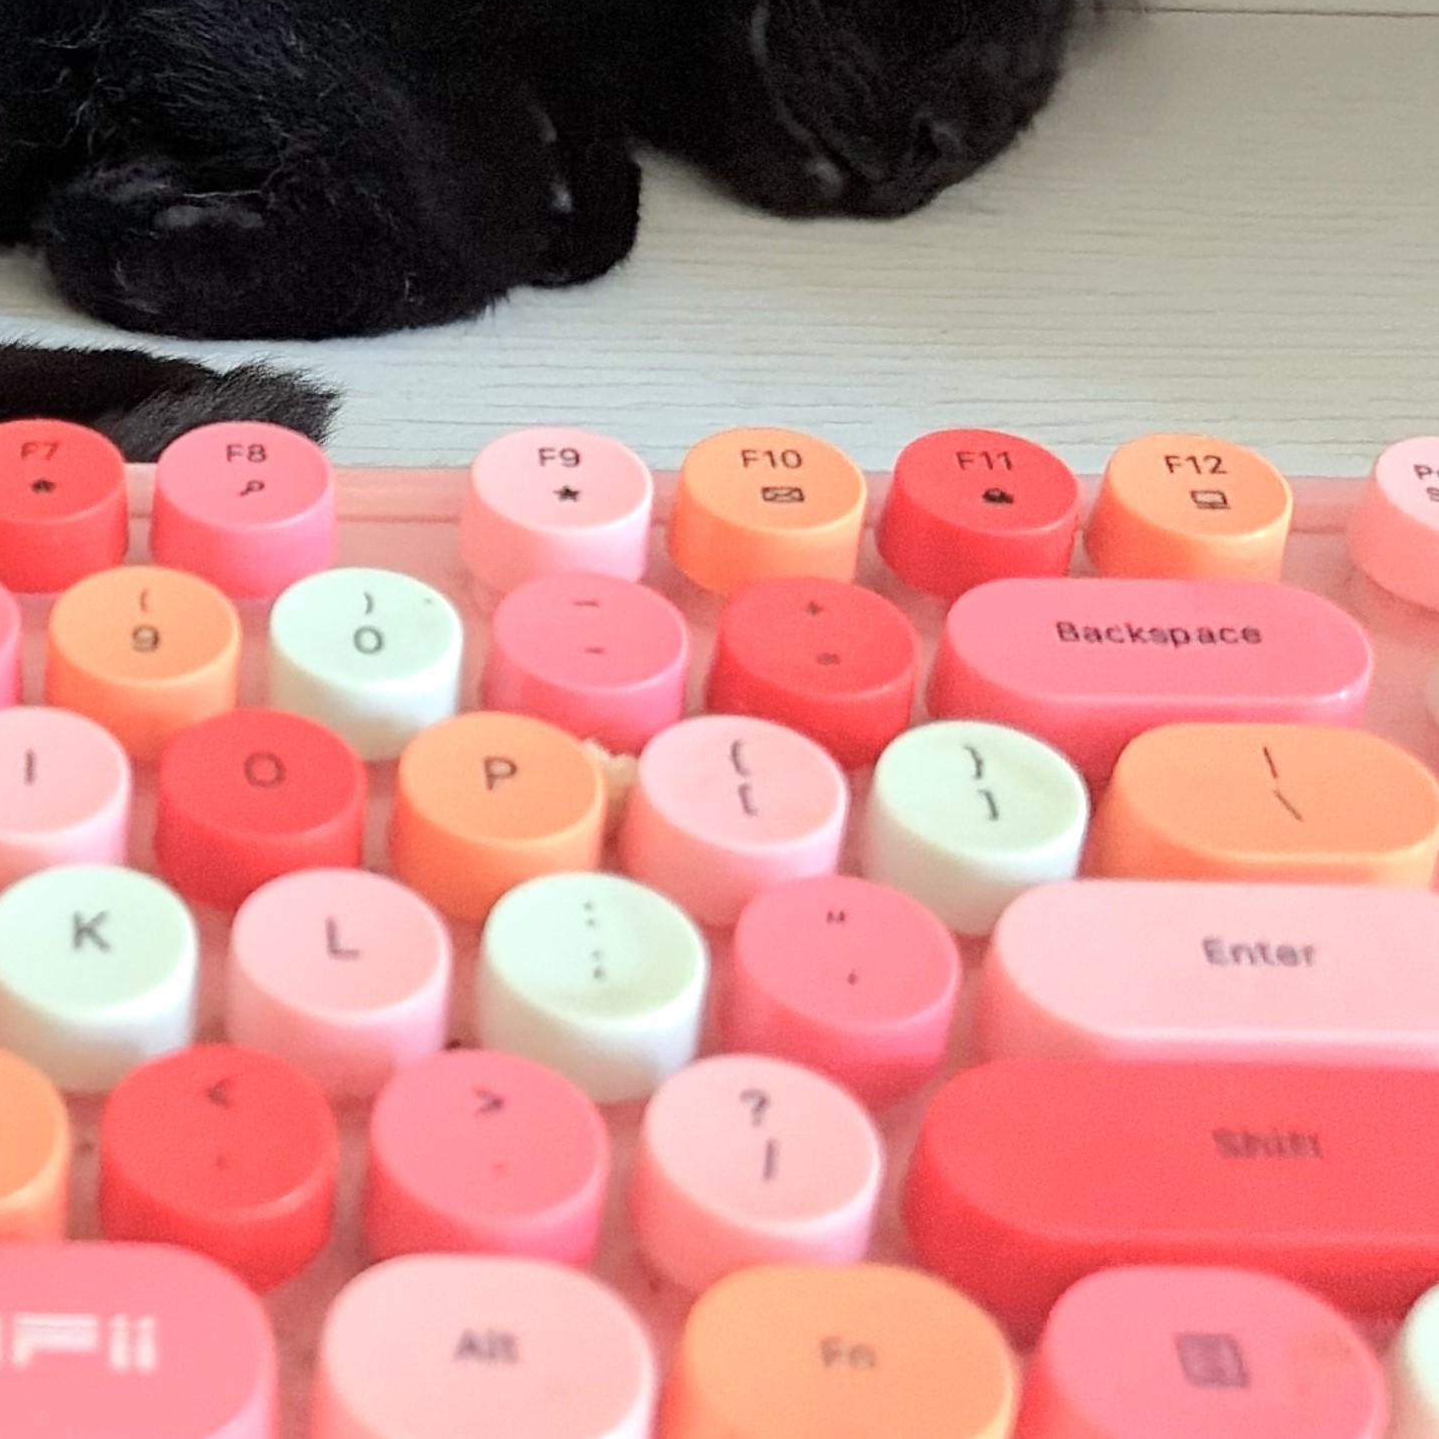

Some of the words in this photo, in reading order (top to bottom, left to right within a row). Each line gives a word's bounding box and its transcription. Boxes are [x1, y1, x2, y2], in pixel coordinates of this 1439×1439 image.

[21, 441, 60, 461] F7
[226, 444, 267, 463] F8
[539, 448, 581, 467] F9
[741, 450, 802, 469] F10
[956, 451, 1012, 470] F11
[1164, 455, 1226, 474] F12
[139, 589, 148, 613] (
[364, 592, 374, 615] )
[132, 625, 161, 652] 9
[1056, 621, 1262, 648] Backspace
[25, 749, 36, 784] I
[484, 757, 519, 791] P
[73, 912, 110, 951] K
[326, 918, 360, 960] L
[1202, 938, 1315, 967] Enter
[476, 1090, 504, 1114] >
[740, 1089, 770, 1126] ?
